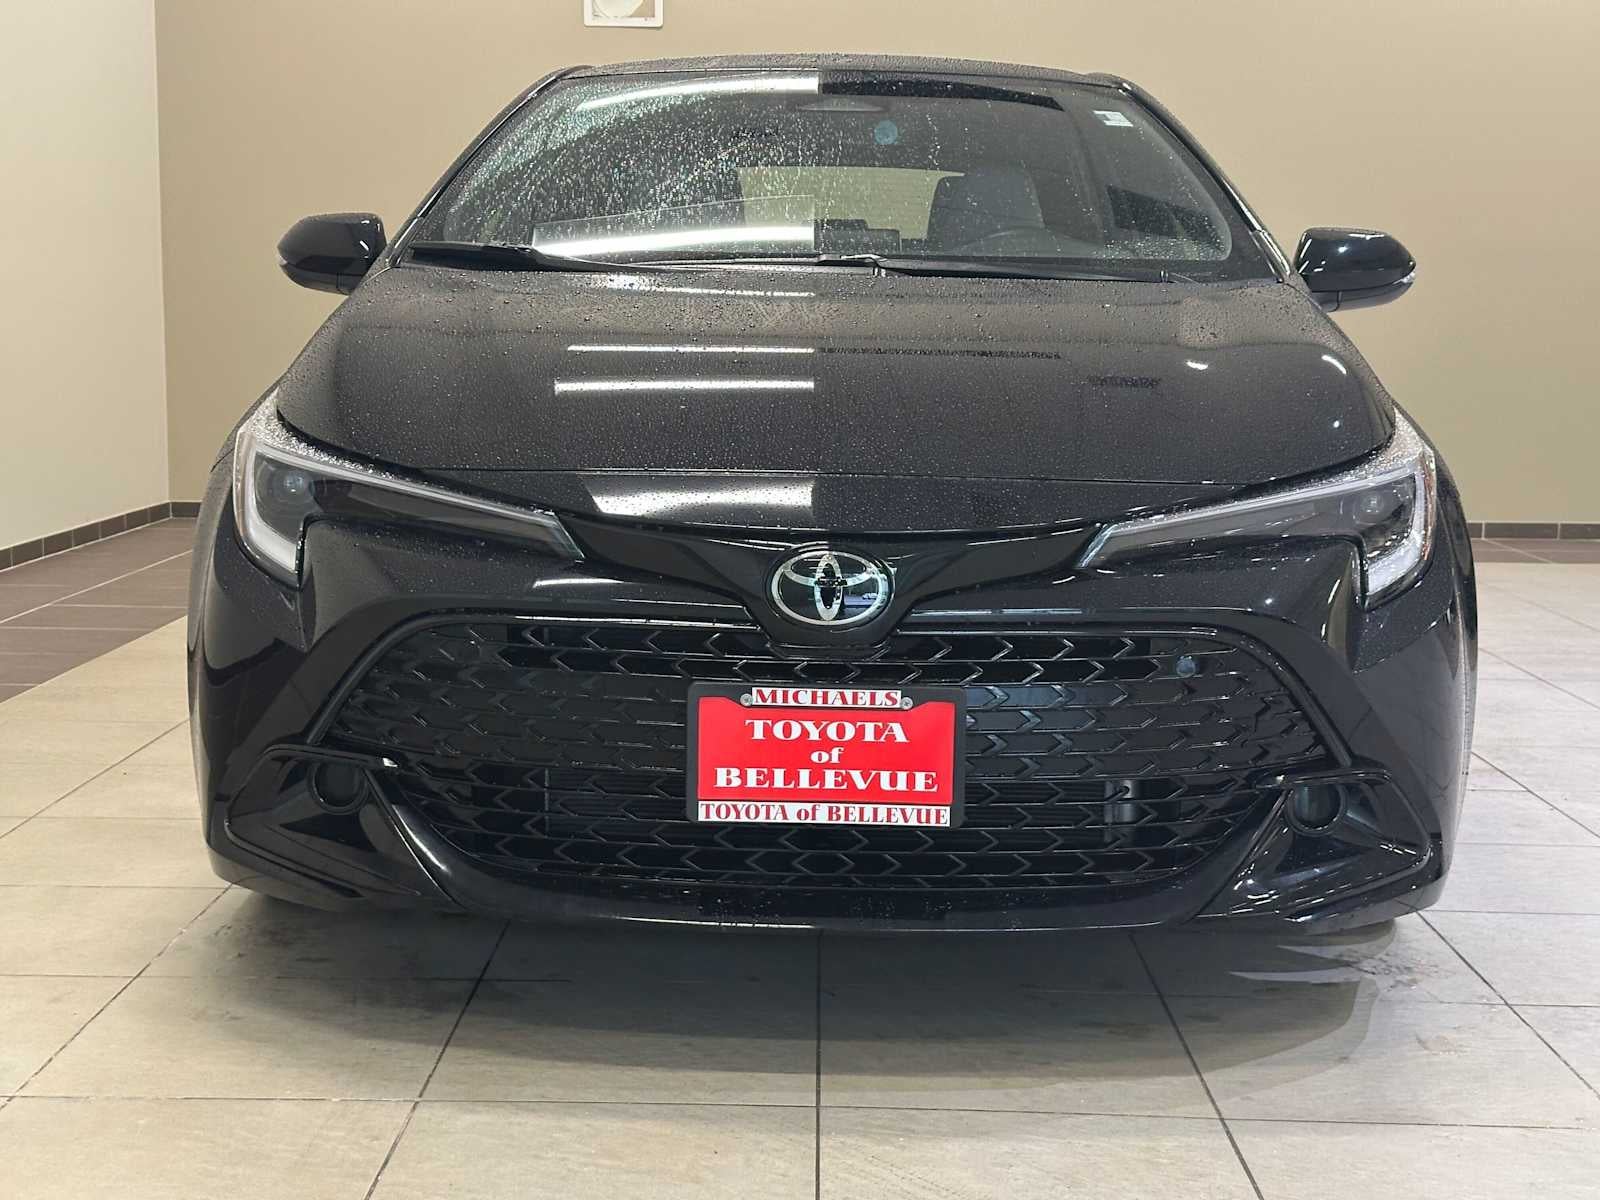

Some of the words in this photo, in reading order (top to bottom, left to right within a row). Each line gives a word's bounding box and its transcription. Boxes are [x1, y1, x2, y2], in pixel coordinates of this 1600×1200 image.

[755, 689, 898, 706] MICHAELS
[745, 719, 909, 743] TOYOTA
[810, 747, 844, 764] of
[714, 767, 938, 792] BELLEVUE
[700, 803, 789, 821] TOYOTA
[796, 804, 819, 821] of
[827, 806, 948, 825] BELLEVUE
